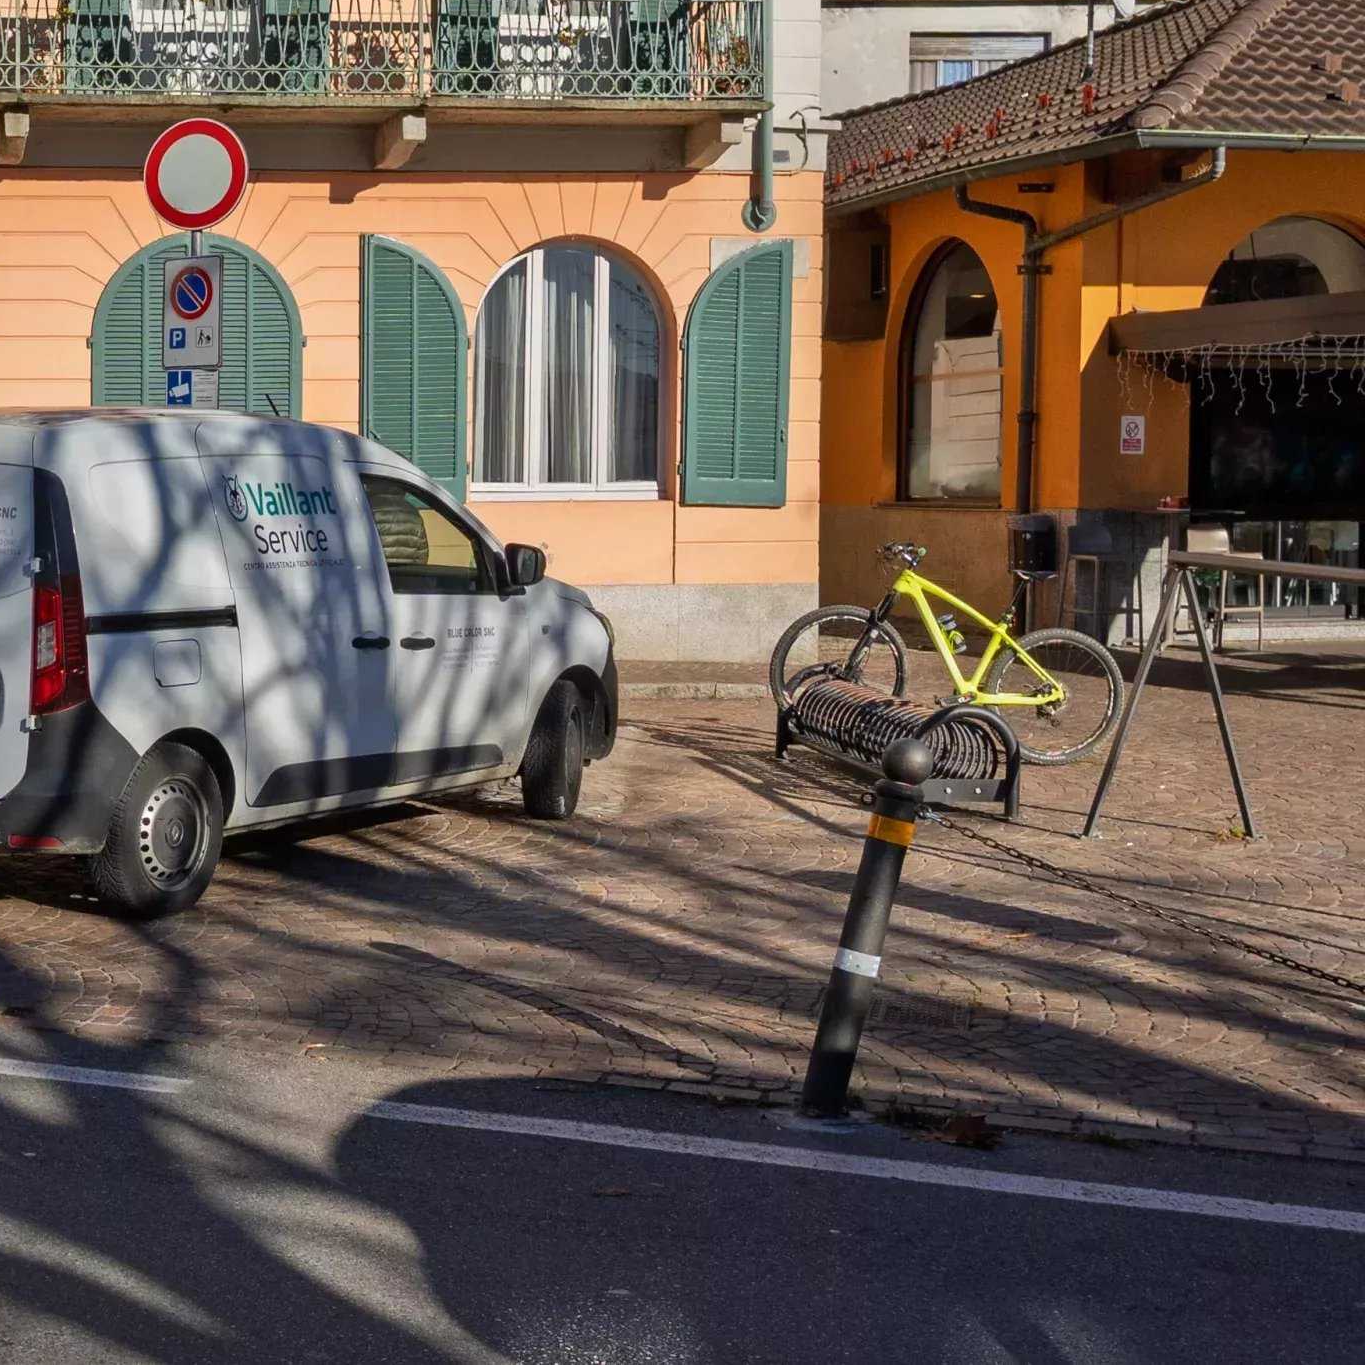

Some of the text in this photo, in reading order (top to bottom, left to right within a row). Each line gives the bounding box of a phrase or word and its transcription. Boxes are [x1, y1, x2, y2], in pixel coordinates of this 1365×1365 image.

[172, 330, 183, 347] P
[245, 482, 336, 516] Vaillant
[253, 523, 329, 554] Service
